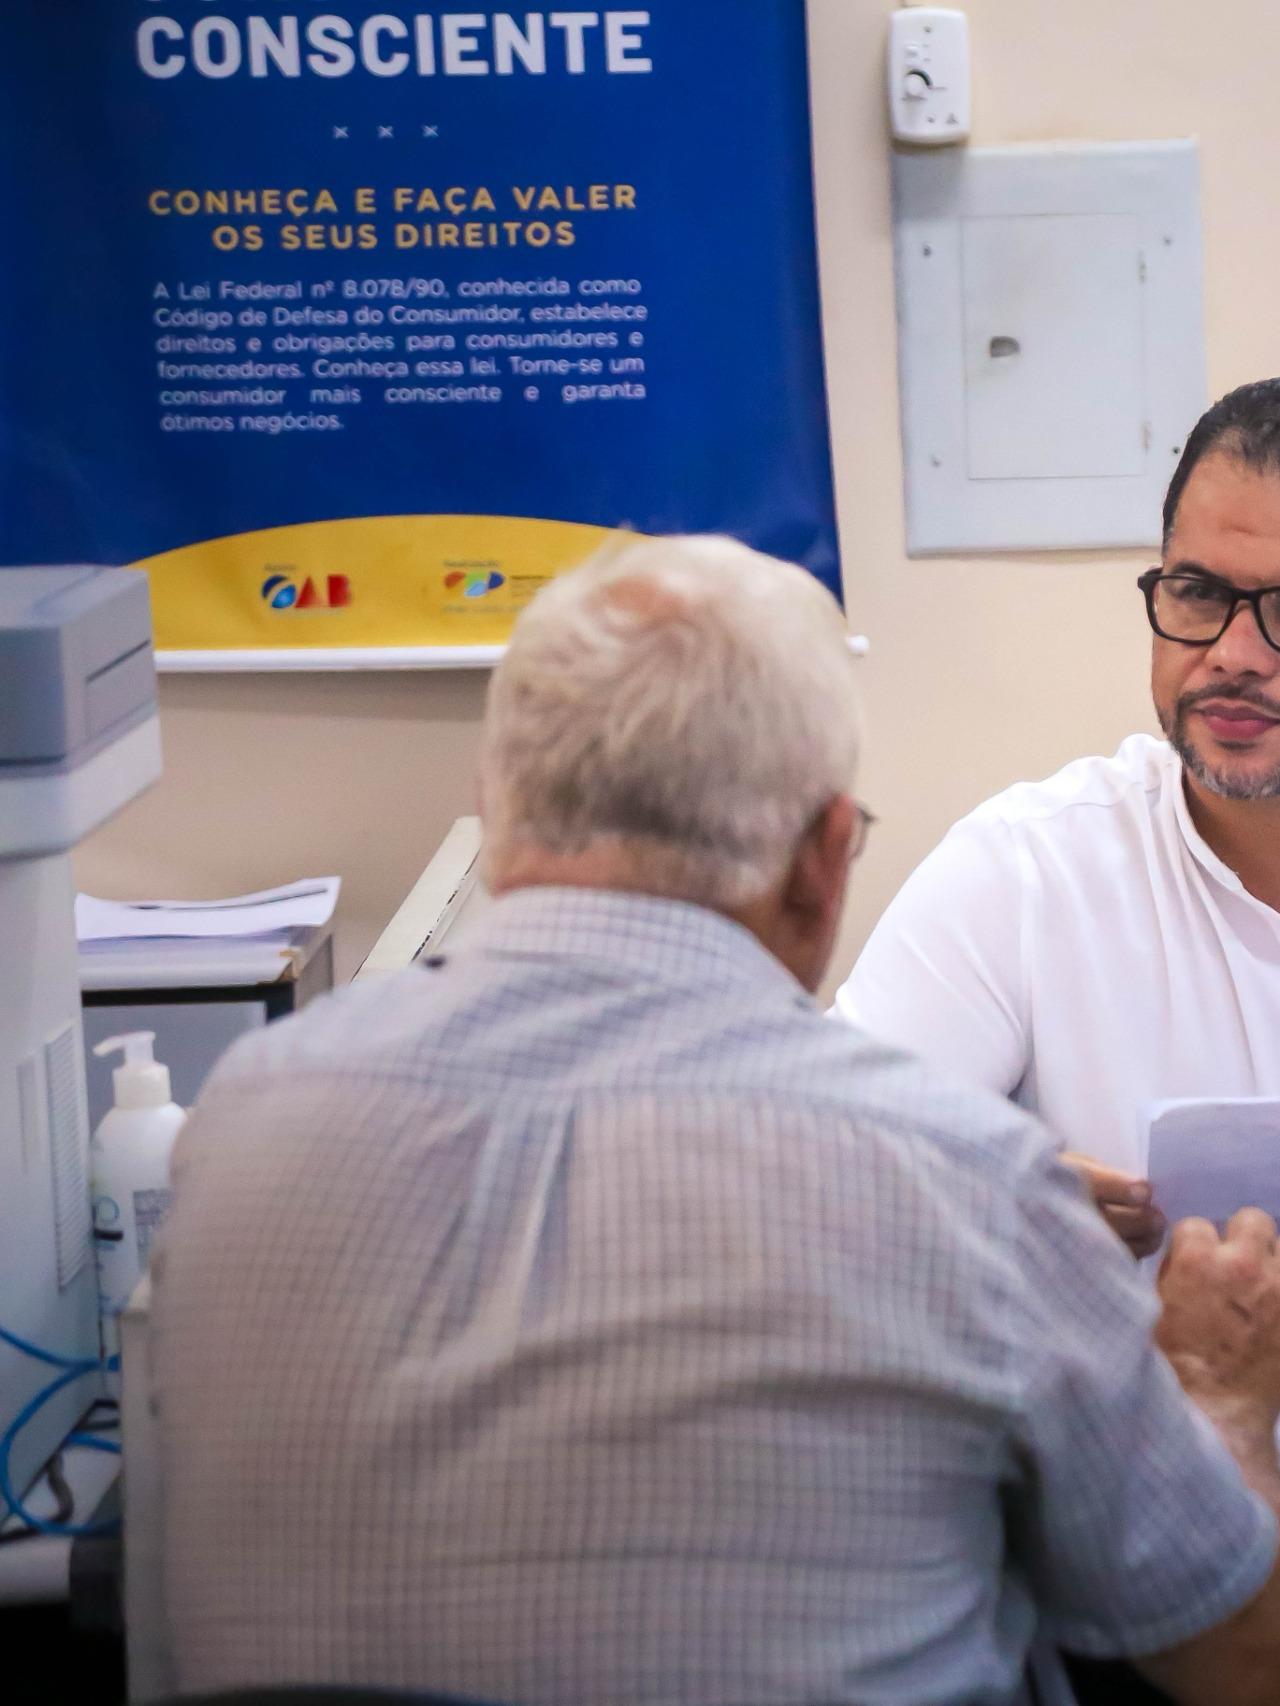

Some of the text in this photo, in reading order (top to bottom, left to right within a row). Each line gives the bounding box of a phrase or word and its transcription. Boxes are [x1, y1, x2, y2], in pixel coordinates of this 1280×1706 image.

[136, 10, 654, 79] CONSCIENTE
[148, 184, 637, 217] CONHEÇA E FAÇA VALER
[212, 221, 576, 251] OS SEUS DIREITOS
[153, 281, 170, 299] A
[178, 281, 211, 300] Lei
[219, 280, 302, 299] Federal
[457, 277, 571, 297] conhecida
[577, 278, 642, 296] como
[154, 302, 648, 331] Código de Defesa do Consumidor, estabelece
[155, 329, 644, 355] direitos e obrigações para consumidores e
[157, 360, 306, 379] fornecedores.
[311, 358, 409, 380] Conheça
[415, 360, 465, 377] essa
[508, 356, 603, 376] Torne-se
[608, 357, 645, 375] um
[158, 381, 647, 406] consumidor mais consciente e garanta
